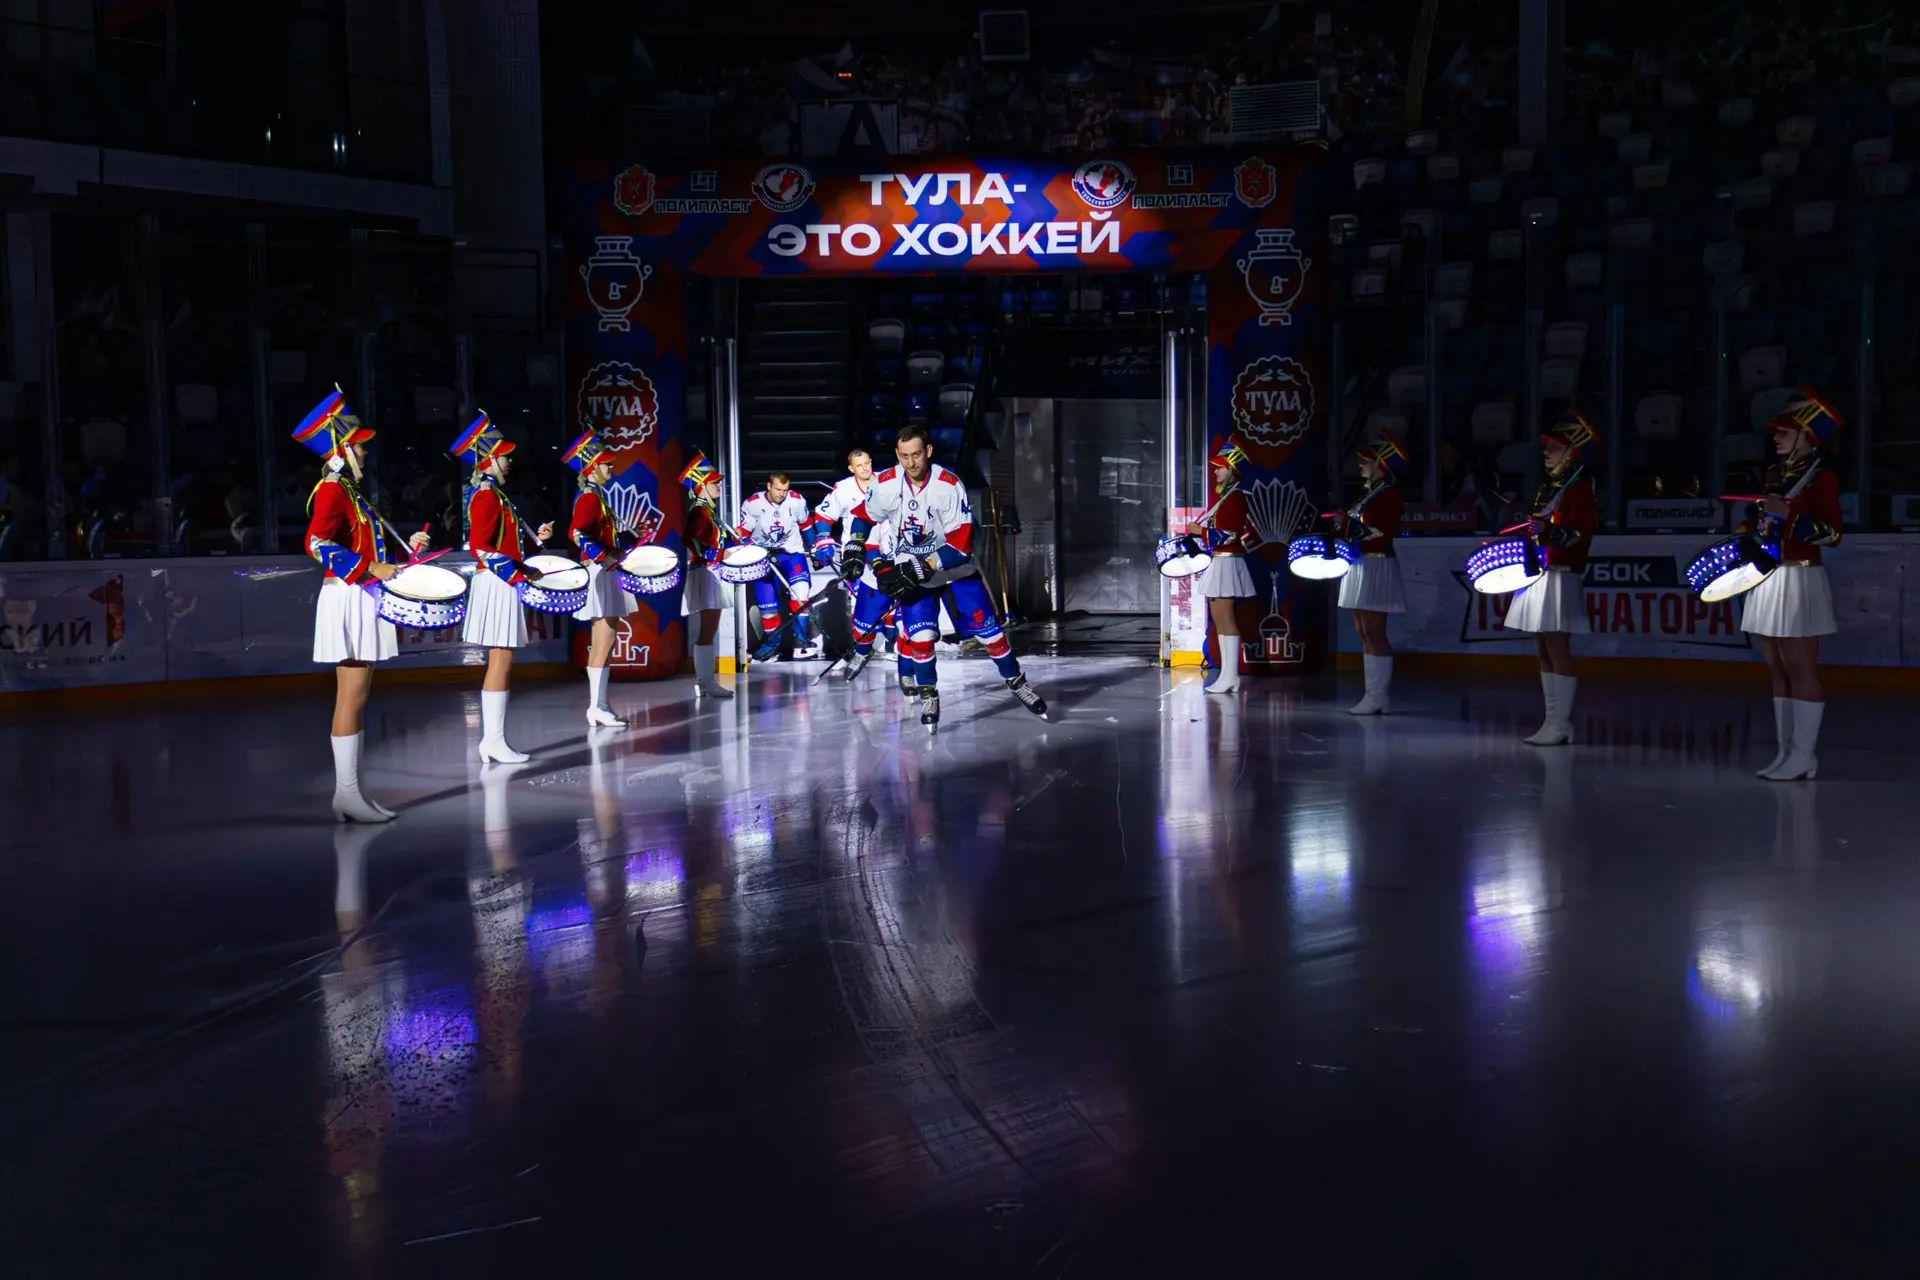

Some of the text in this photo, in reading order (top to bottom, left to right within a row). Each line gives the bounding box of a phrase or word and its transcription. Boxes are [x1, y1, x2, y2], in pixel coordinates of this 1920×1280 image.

[859, 172, 1027, 206] ТУЛА-
[1132, 191, 1233, 209] ПОЛИПЛАСТ
[653, 198, 757, 214] ПОЛИПЛАСТ
[767, 209, 1121, 257] ЭТО ХОККЕЙ
[586, 395, 644, 420] ТУЛА
[1244, 390, 1302, 415] ТУЛА
